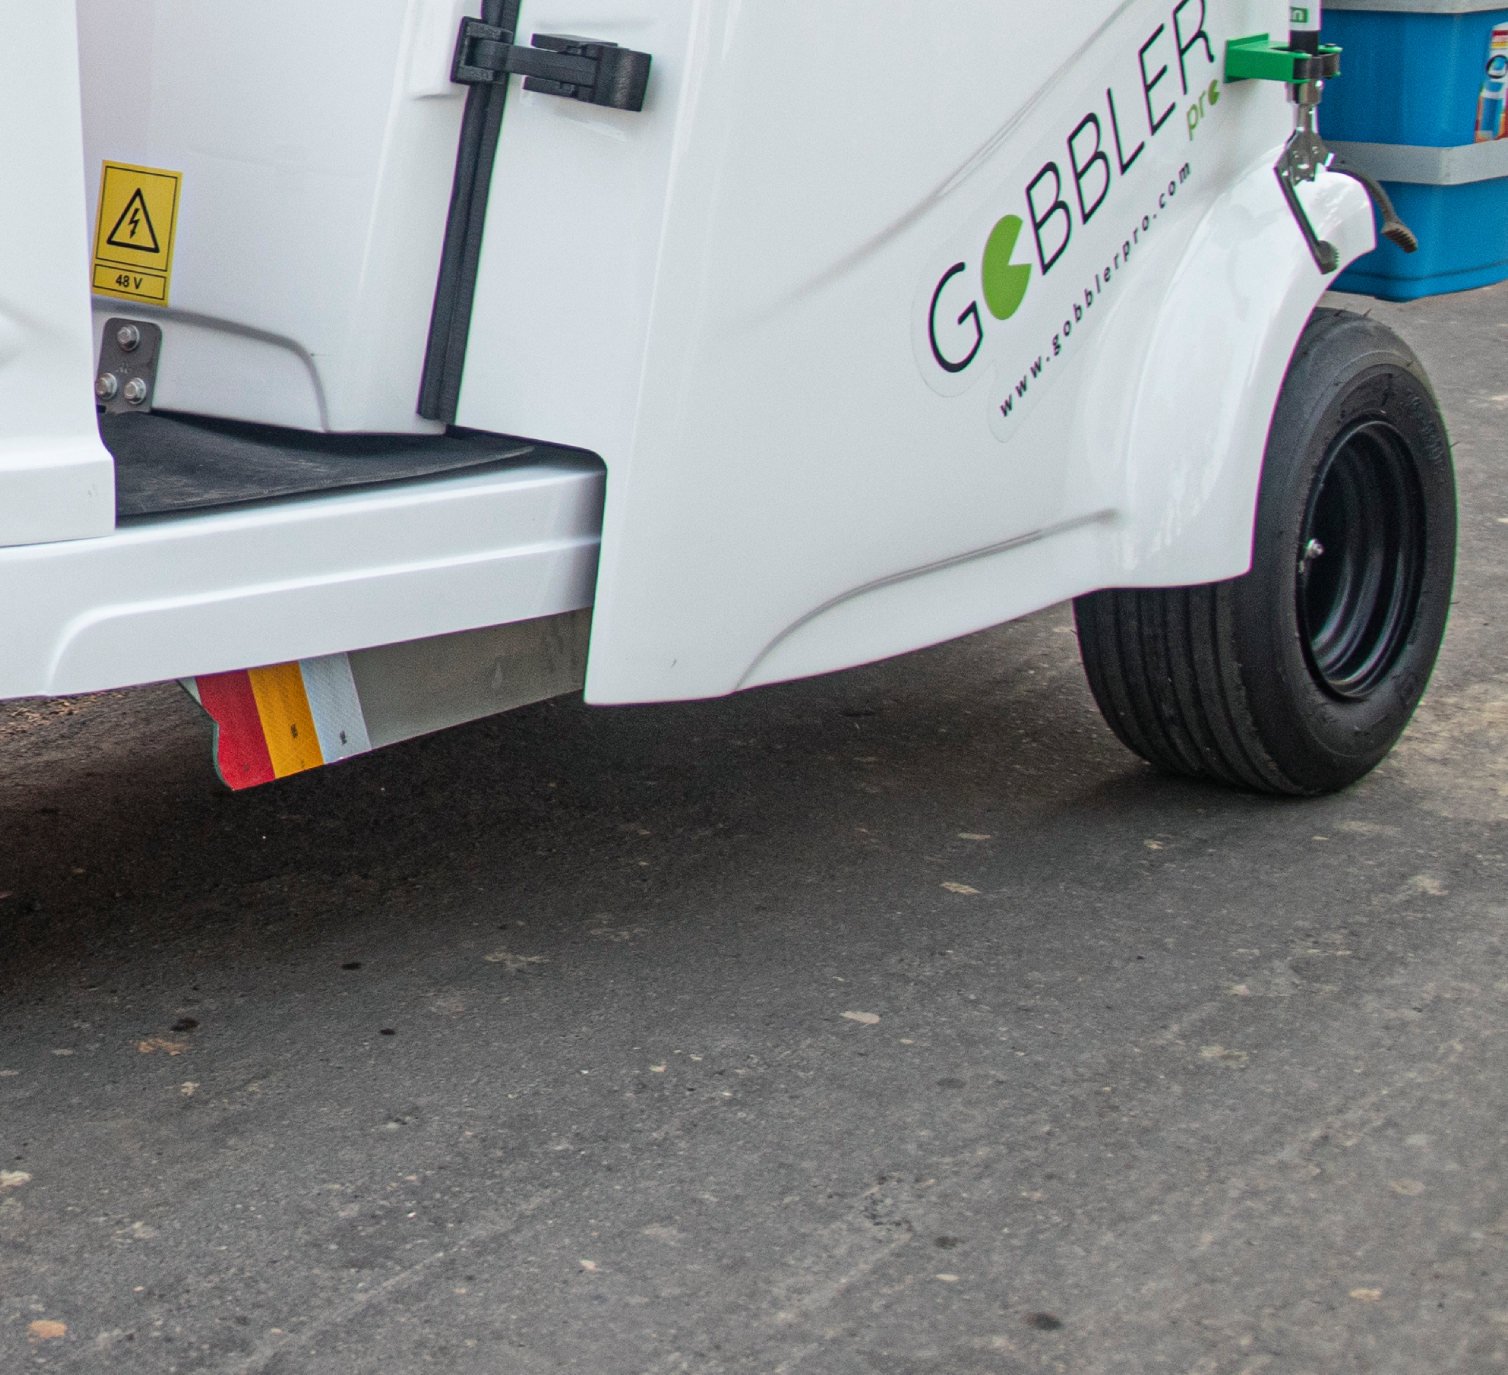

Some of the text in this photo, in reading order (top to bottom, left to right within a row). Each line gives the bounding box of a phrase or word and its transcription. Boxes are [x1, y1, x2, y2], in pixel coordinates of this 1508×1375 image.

[1185, 78, 1221, 141] pro
[115, 274, 143, 290] 48 V
[999, 160, 1192, 418] www.gobblerpro.com
